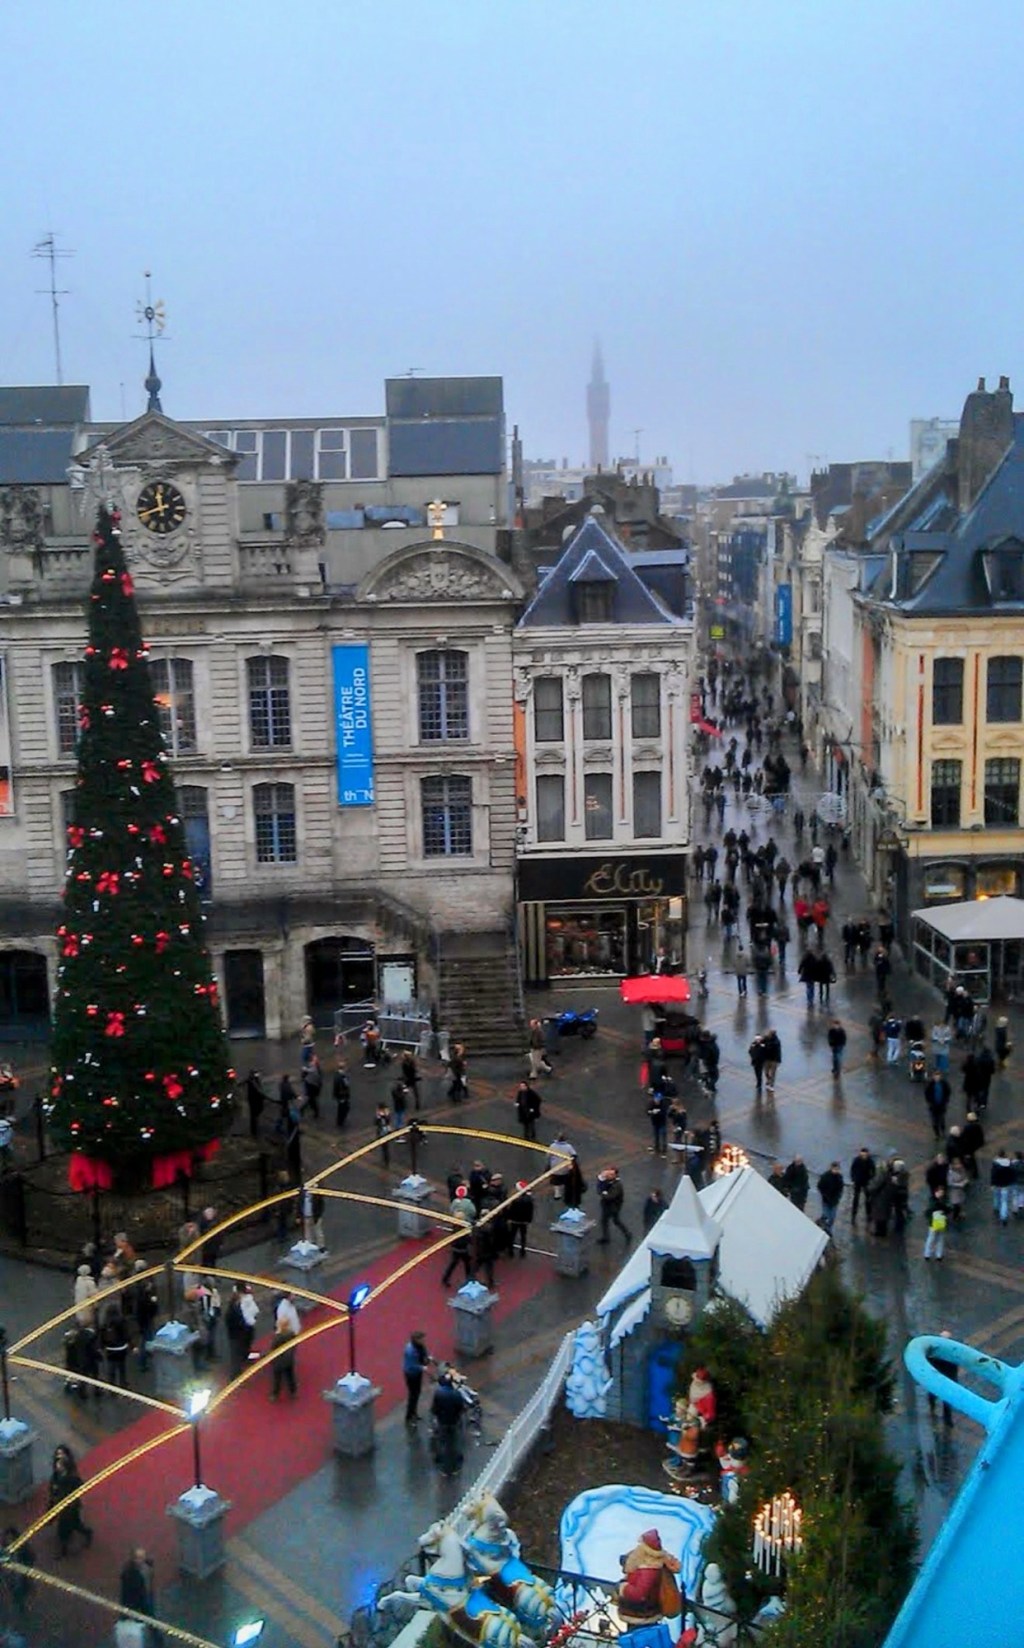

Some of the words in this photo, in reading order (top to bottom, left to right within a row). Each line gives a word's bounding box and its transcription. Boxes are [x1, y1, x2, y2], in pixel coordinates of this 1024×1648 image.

[353, 667, 367, 707] NORD
[338, 686, 355, 748] THÉÂTRE
[355, 709, 367, 729] DU
